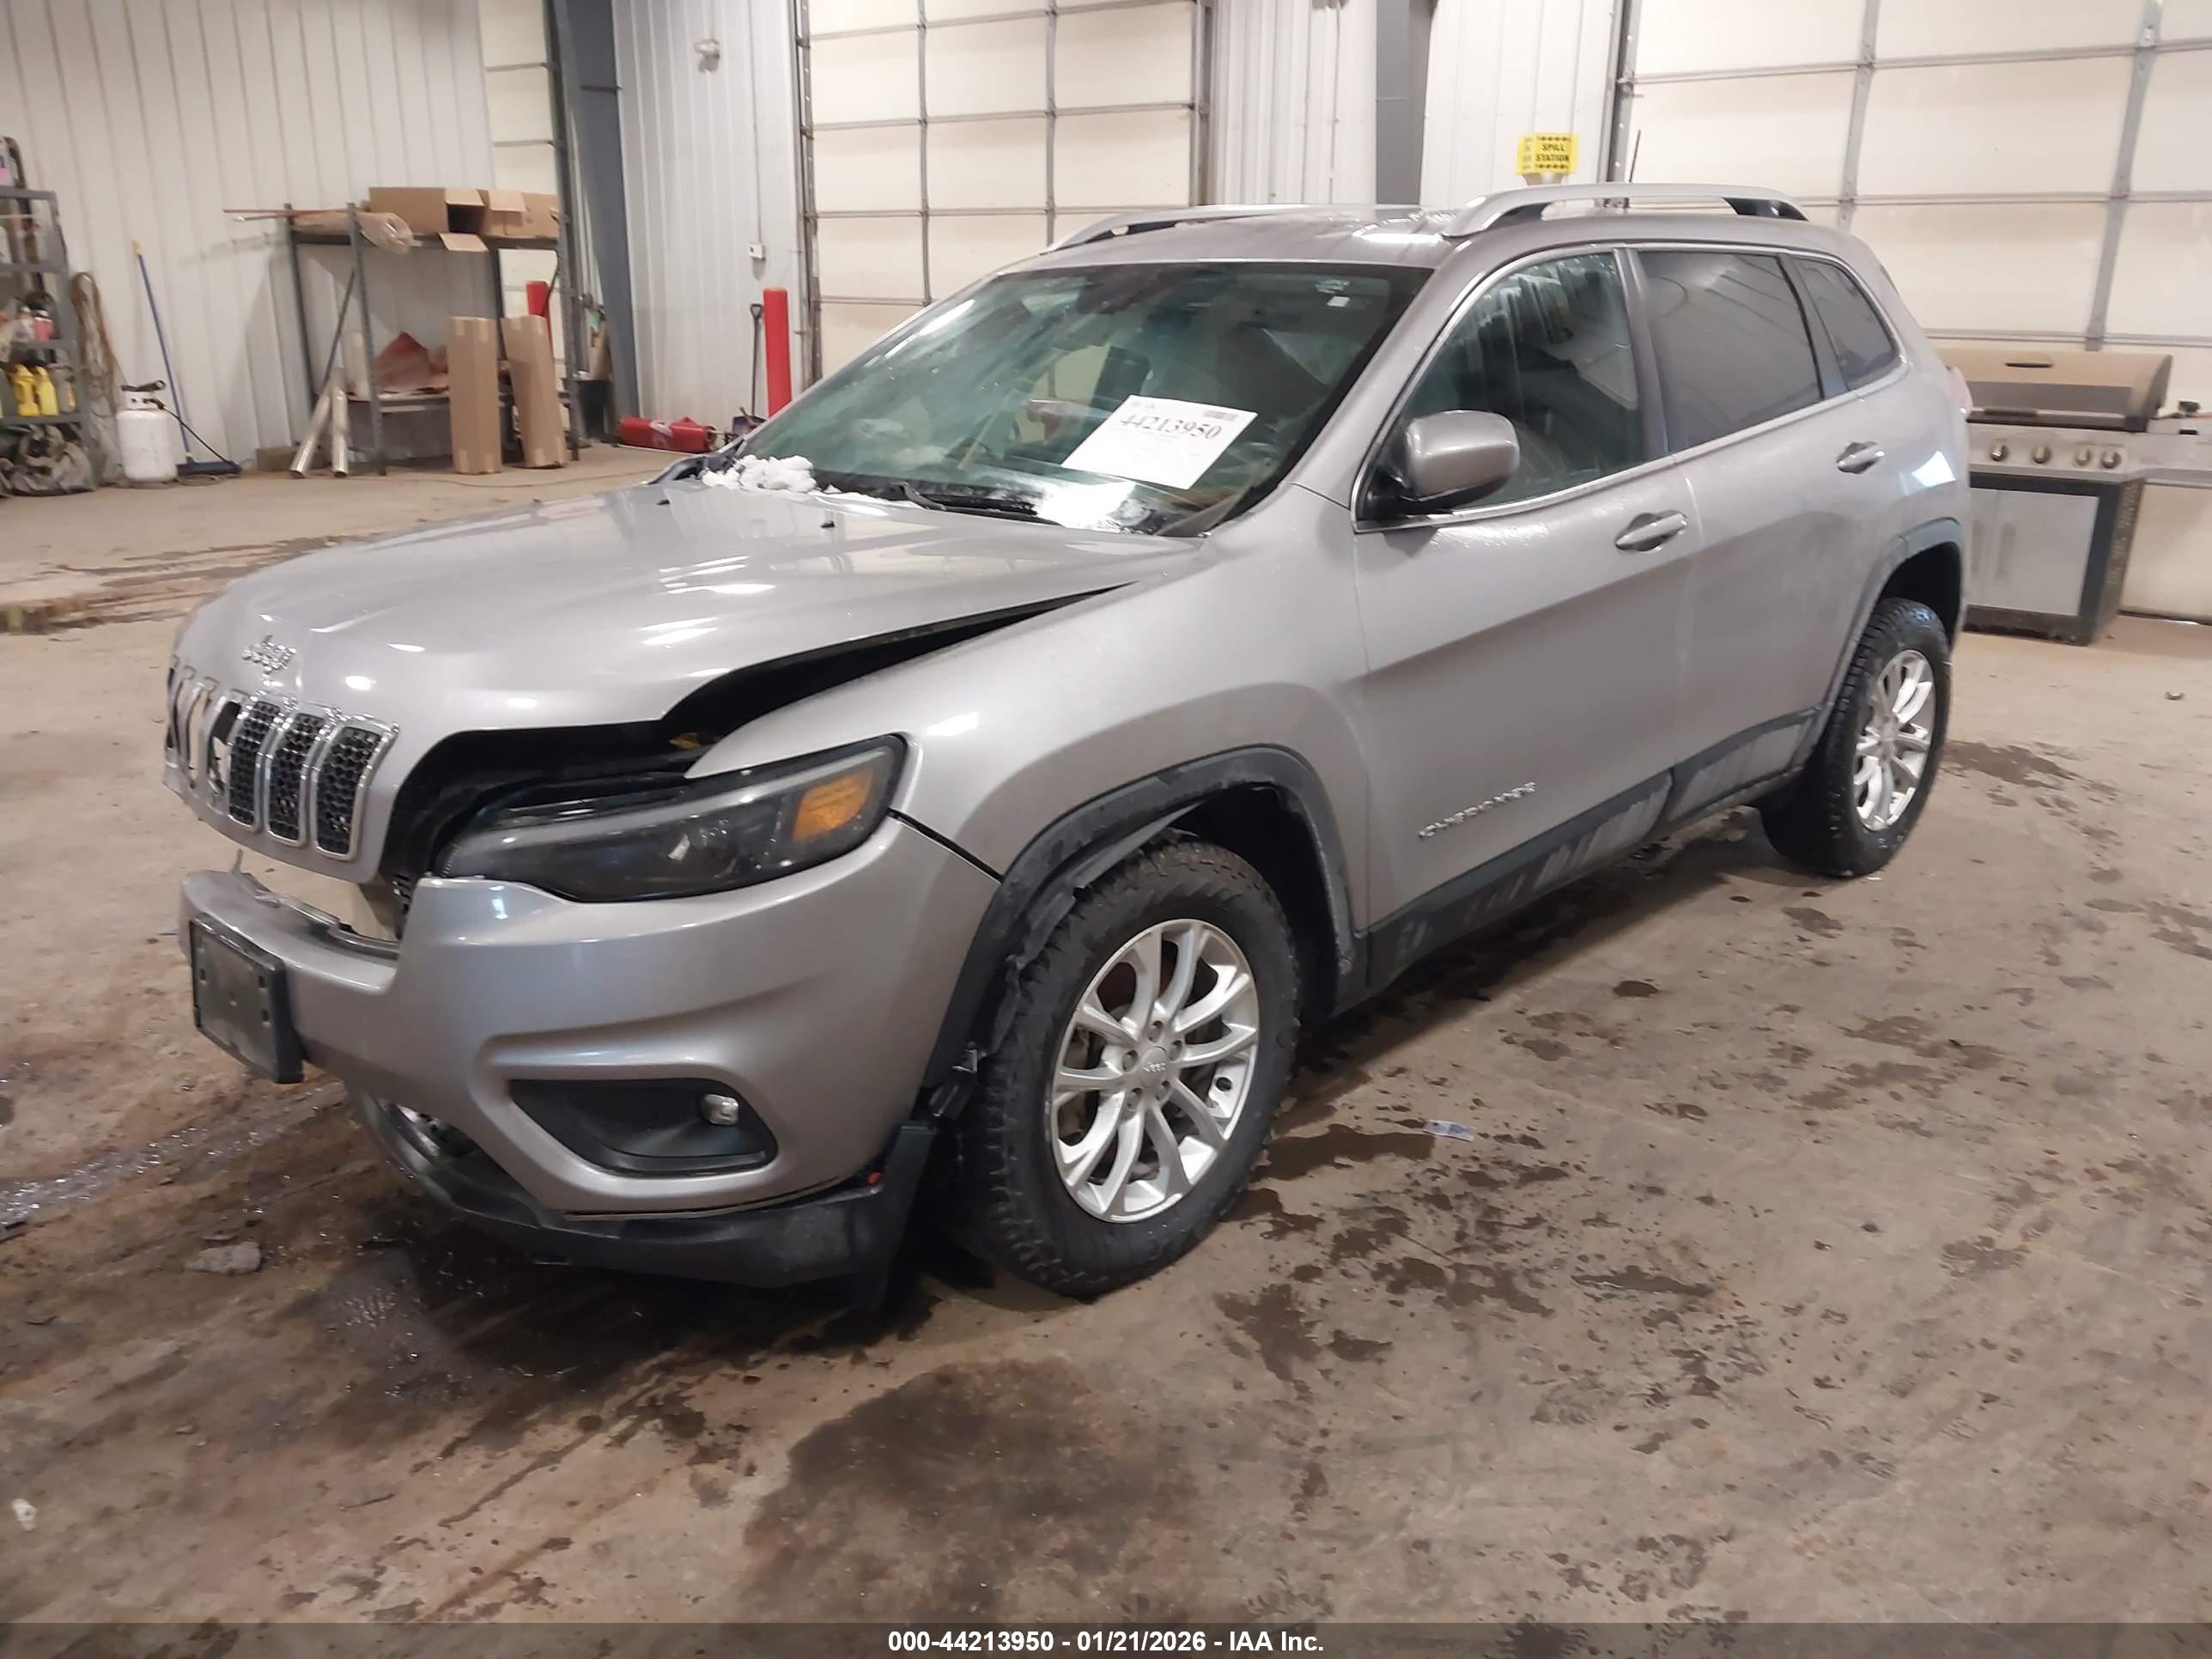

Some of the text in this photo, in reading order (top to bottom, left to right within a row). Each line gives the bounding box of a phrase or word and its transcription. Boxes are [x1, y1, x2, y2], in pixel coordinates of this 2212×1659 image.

[1542, 143, 1565, 151] SPILL
[1535, 154, 1570, 162] STATION
[1120, 413, 1223, 440] 44213950
